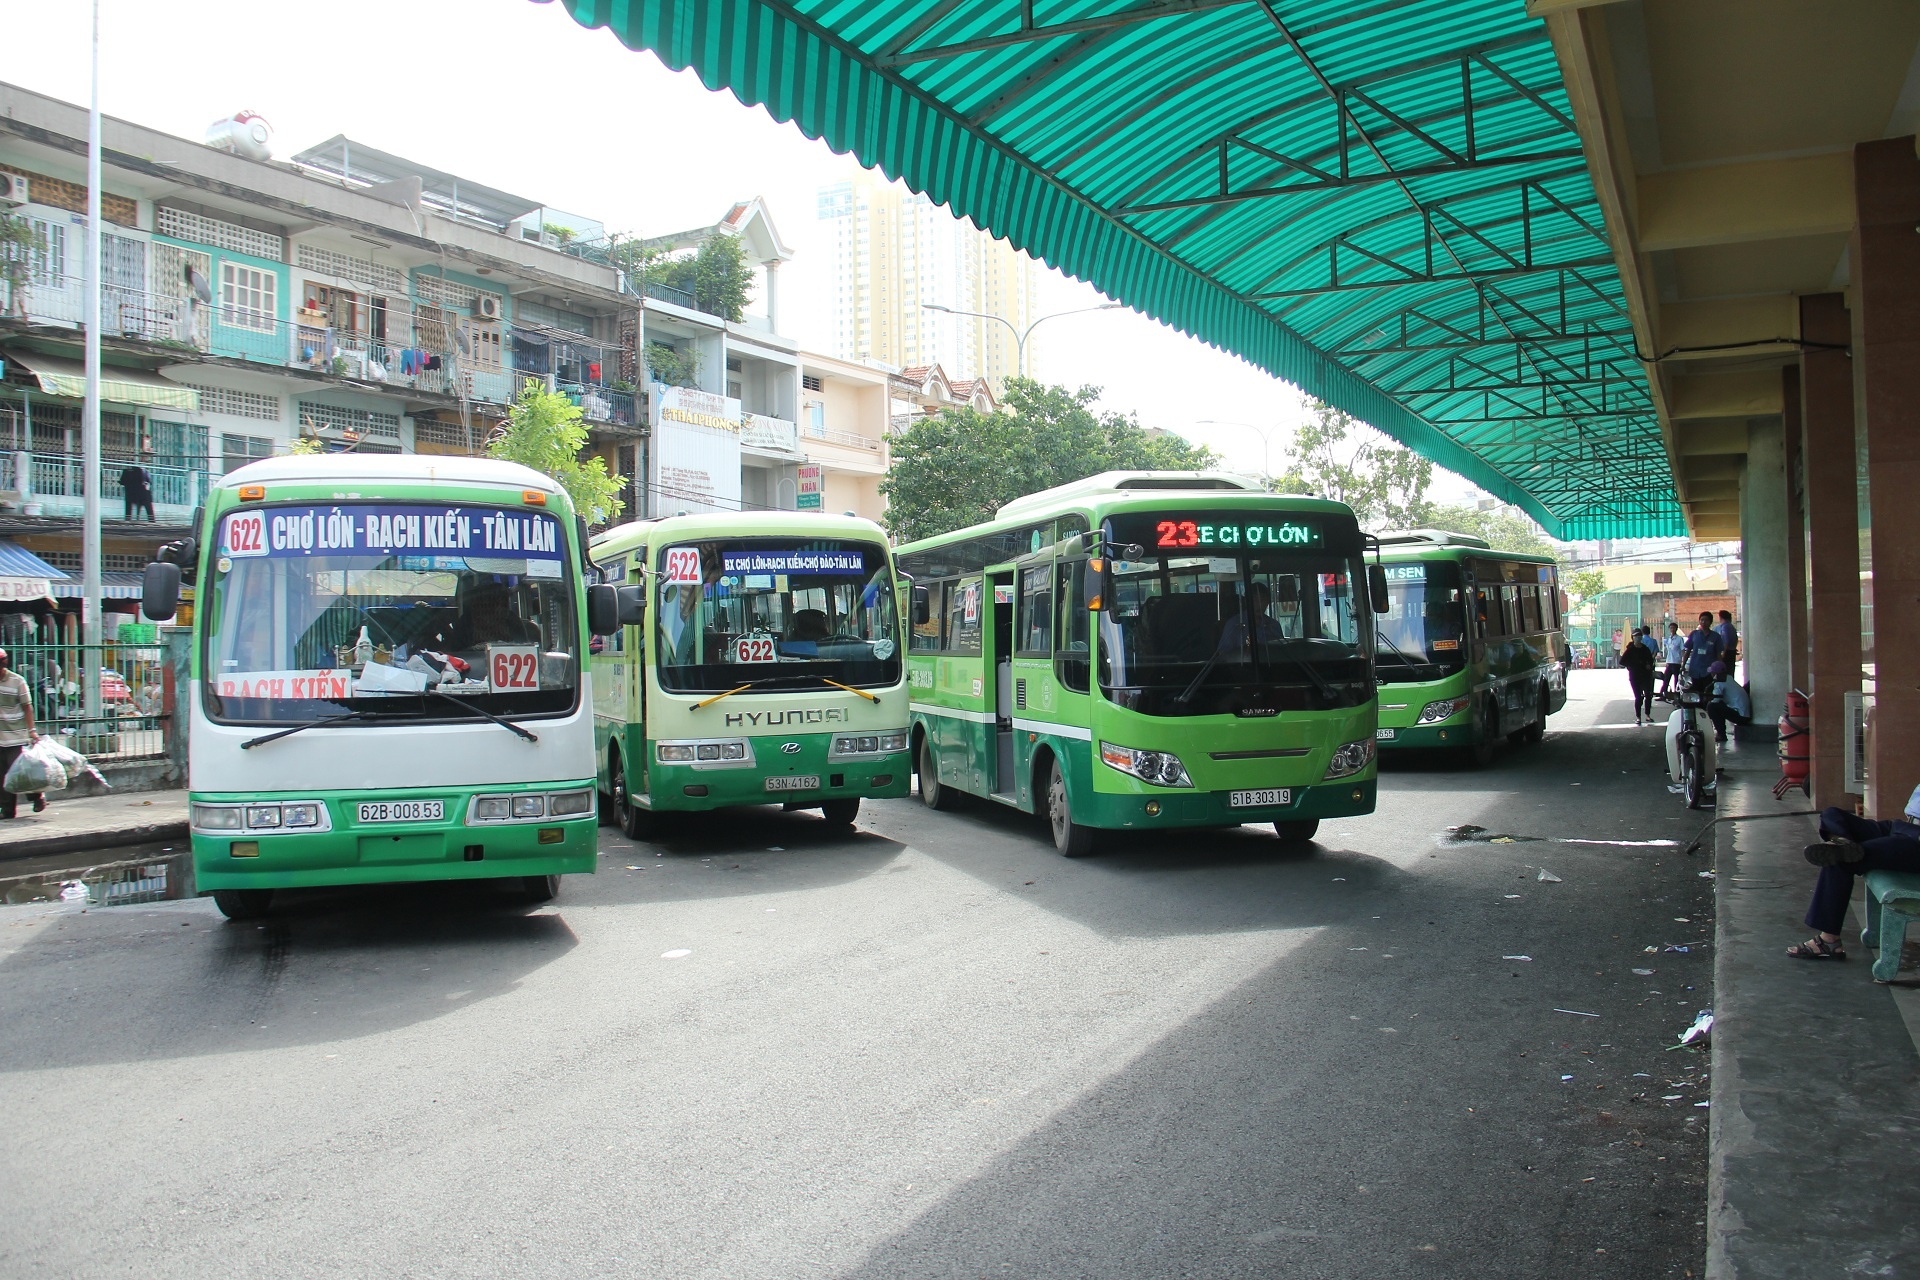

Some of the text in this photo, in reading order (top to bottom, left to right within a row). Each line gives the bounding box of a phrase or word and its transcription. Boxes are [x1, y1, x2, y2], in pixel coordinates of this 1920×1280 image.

[231, 518, 261, 551] 622
[273, 510, 314, 554] CHỢ
[318, 507, 354, 548] LỚN
[366, 514, 420, 553] RẠCH
[424, 508, 470, 548] KIẾN
[482, 511, 519, 550] TÂN
[523, 514, 556, 552] LÂN
[1157, 521, 1198, 546] 23
[1197, 526, 1213, 543] E
[1267, 522, 1308, 543] LỚN
[669, 551, 698, 581] 622
[725, 559, 735, 571] BX
[736, 556, 751, 573] CHỢ
[849, 555, 862, 569] LÂN
[1398, 566, 1424, 578] SEN
[739, 640, 773, 661] 622
[493, 653, 537, 688] 622
[725, 706, 849, 727] HYUNDAI
[1232, 790, 1289, 805] 51B-303.19
[361, 803, 441, 820] 62B-008.53
